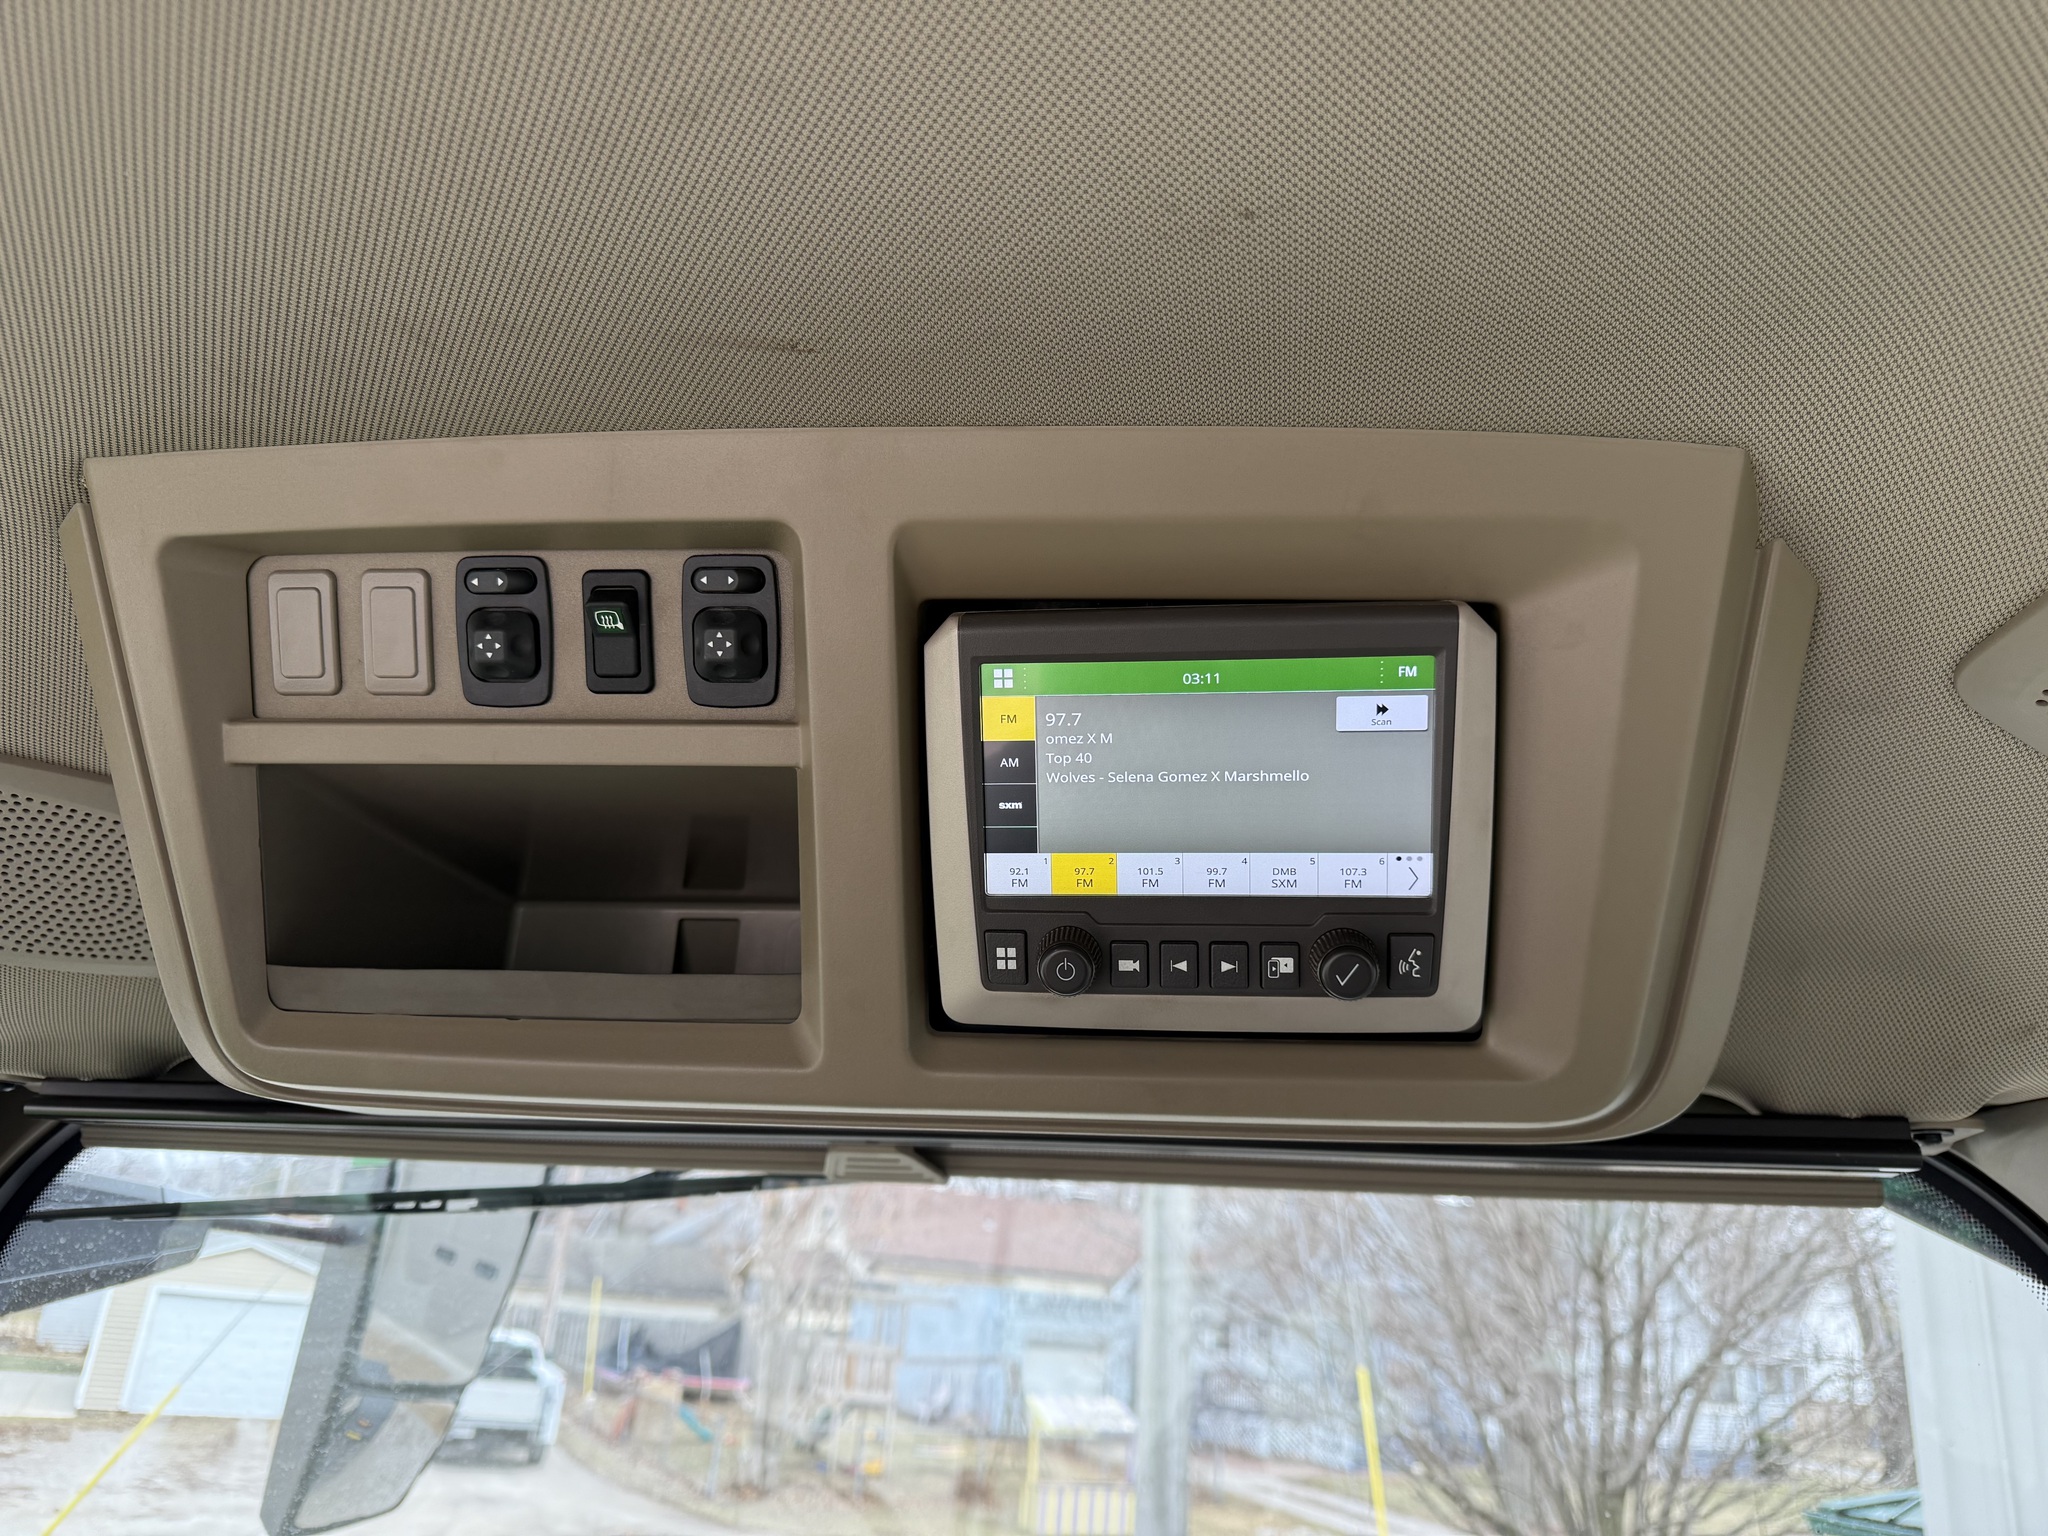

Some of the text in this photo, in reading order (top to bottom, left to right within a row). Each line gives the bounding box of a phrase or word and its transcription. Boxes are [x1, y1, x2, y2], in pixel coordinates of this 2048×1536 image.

[1398, 665, 1418, 677] FM
[1182, 672, 1220, 685] 03:11
[1000, 714, 1017, 724] FM
[1045, 712, 1082, 727] 97.7
[1371, 718, 1392, 726] Scan
[1045, 732, 1113, 745] omez X M
[999, 757, 1019, 768] AM
[1045, 752, 1093, 767] Top 40
[1046, 771, 1096, 783] Wolves
[1108, 771, 1154, 783] Selena
[1158, 770, 1207, 782] Gomez
[1210, 771, 1221, 782] X
[1224, 769, 1310, 782] Marshmello
[998, 801, 1023, 810] sxm
[1043, 857, 1048, 865] 1
[1108, 857, 1114, 865] 2
[1174, 857, 1181, 865] 3
[1241, 857, 1248, 865] 4
[1309, 857, 1316, 865] 5
[1378, 857, 1385, 865] 6
[1009, 867, 1029, 876] 92.1
[1074, 867, 1095, 876] 97.7
[1137, 867, 1164, 876] 101.5
[1206, 867, 1227, 876] 99.7
[1272, 867, 1297, 876] DMB
[1339, 867, 1367, 876] 107.3
[1011, 878, 1028, 888] FM
[1076, 878, 1094, 888] FM
[1142, 878, 1159, 888] FM
[1208, 878, 1226, 888] FM
[1271, 879, 1298, 889] SXM
[1344, 879, 1362, 889] FM
